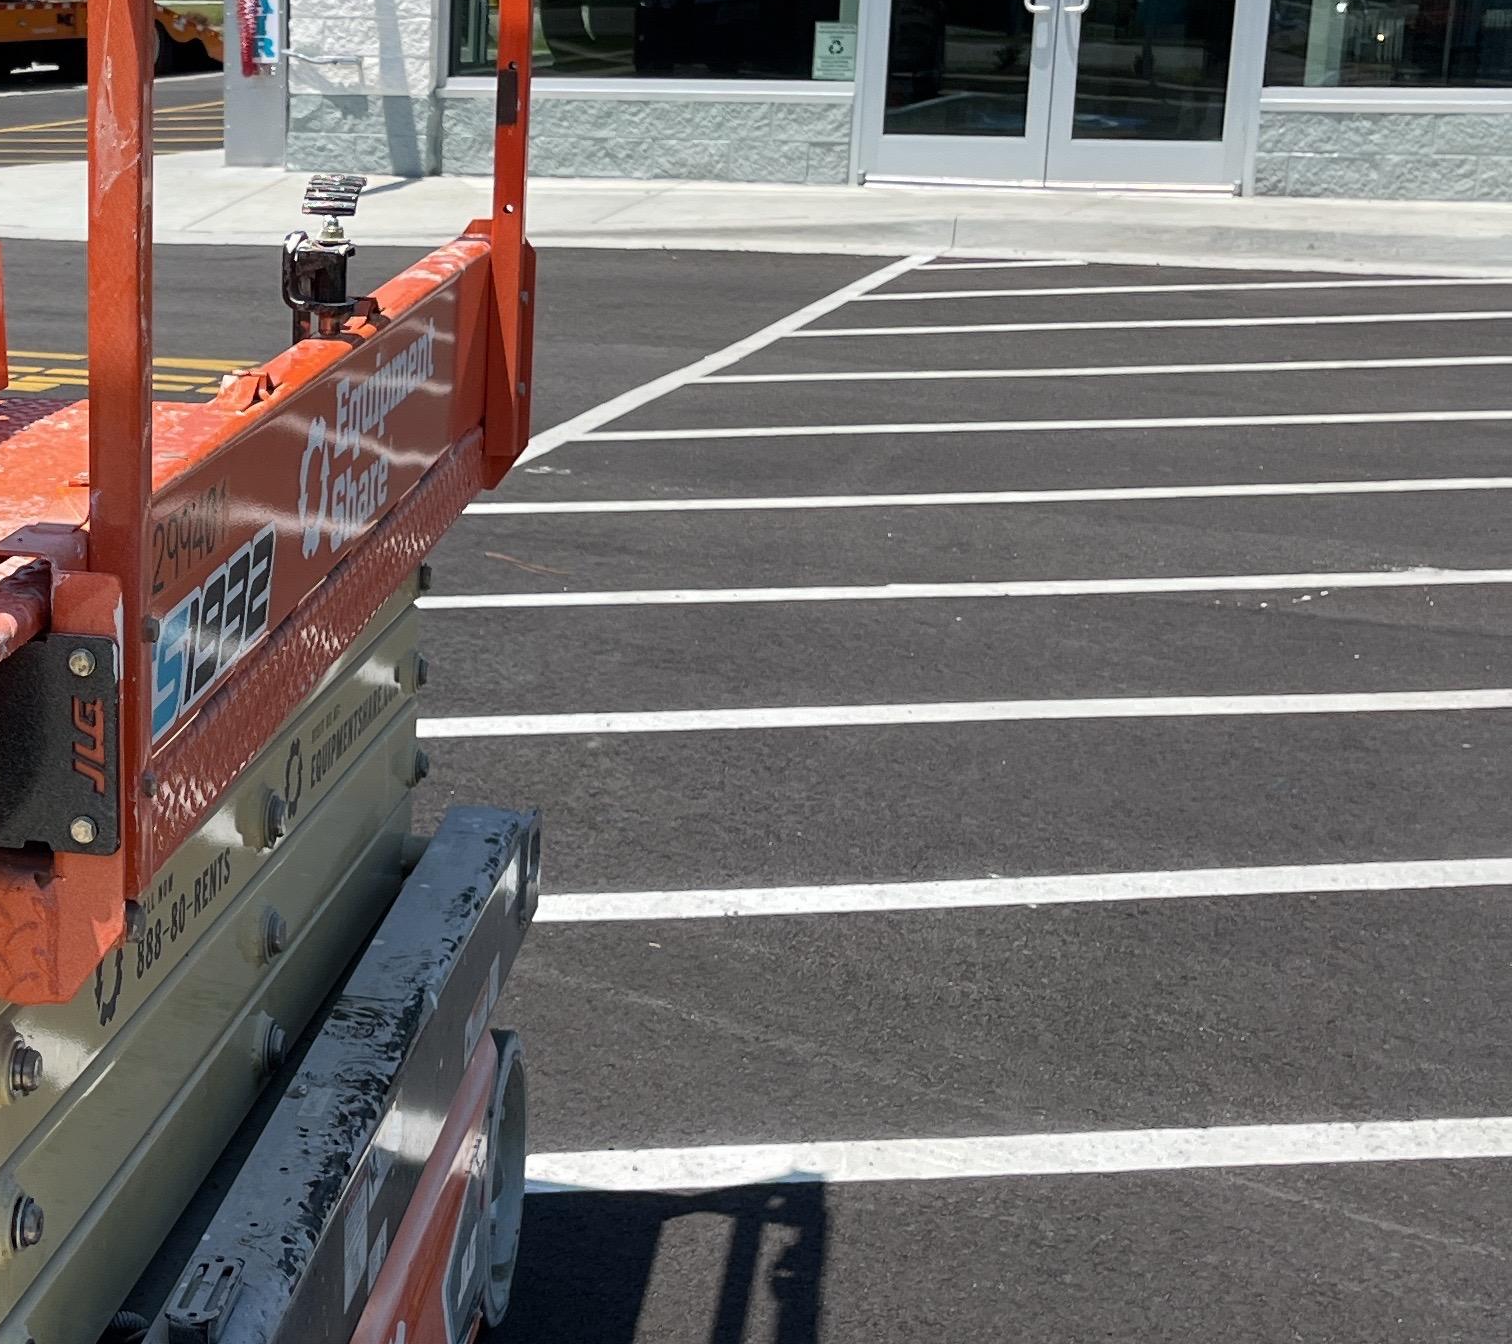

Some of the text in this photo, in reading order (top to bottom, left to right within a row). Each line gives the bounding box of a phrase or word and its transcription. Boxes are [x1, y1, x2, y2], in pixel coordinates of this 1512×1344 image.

[333, 317, 436, 459] Equipment
[329, 451, 389, 554] Share
[72, 695, 105, 796] JLG
[136, 846, 232, 980] 888-80-RENTS
